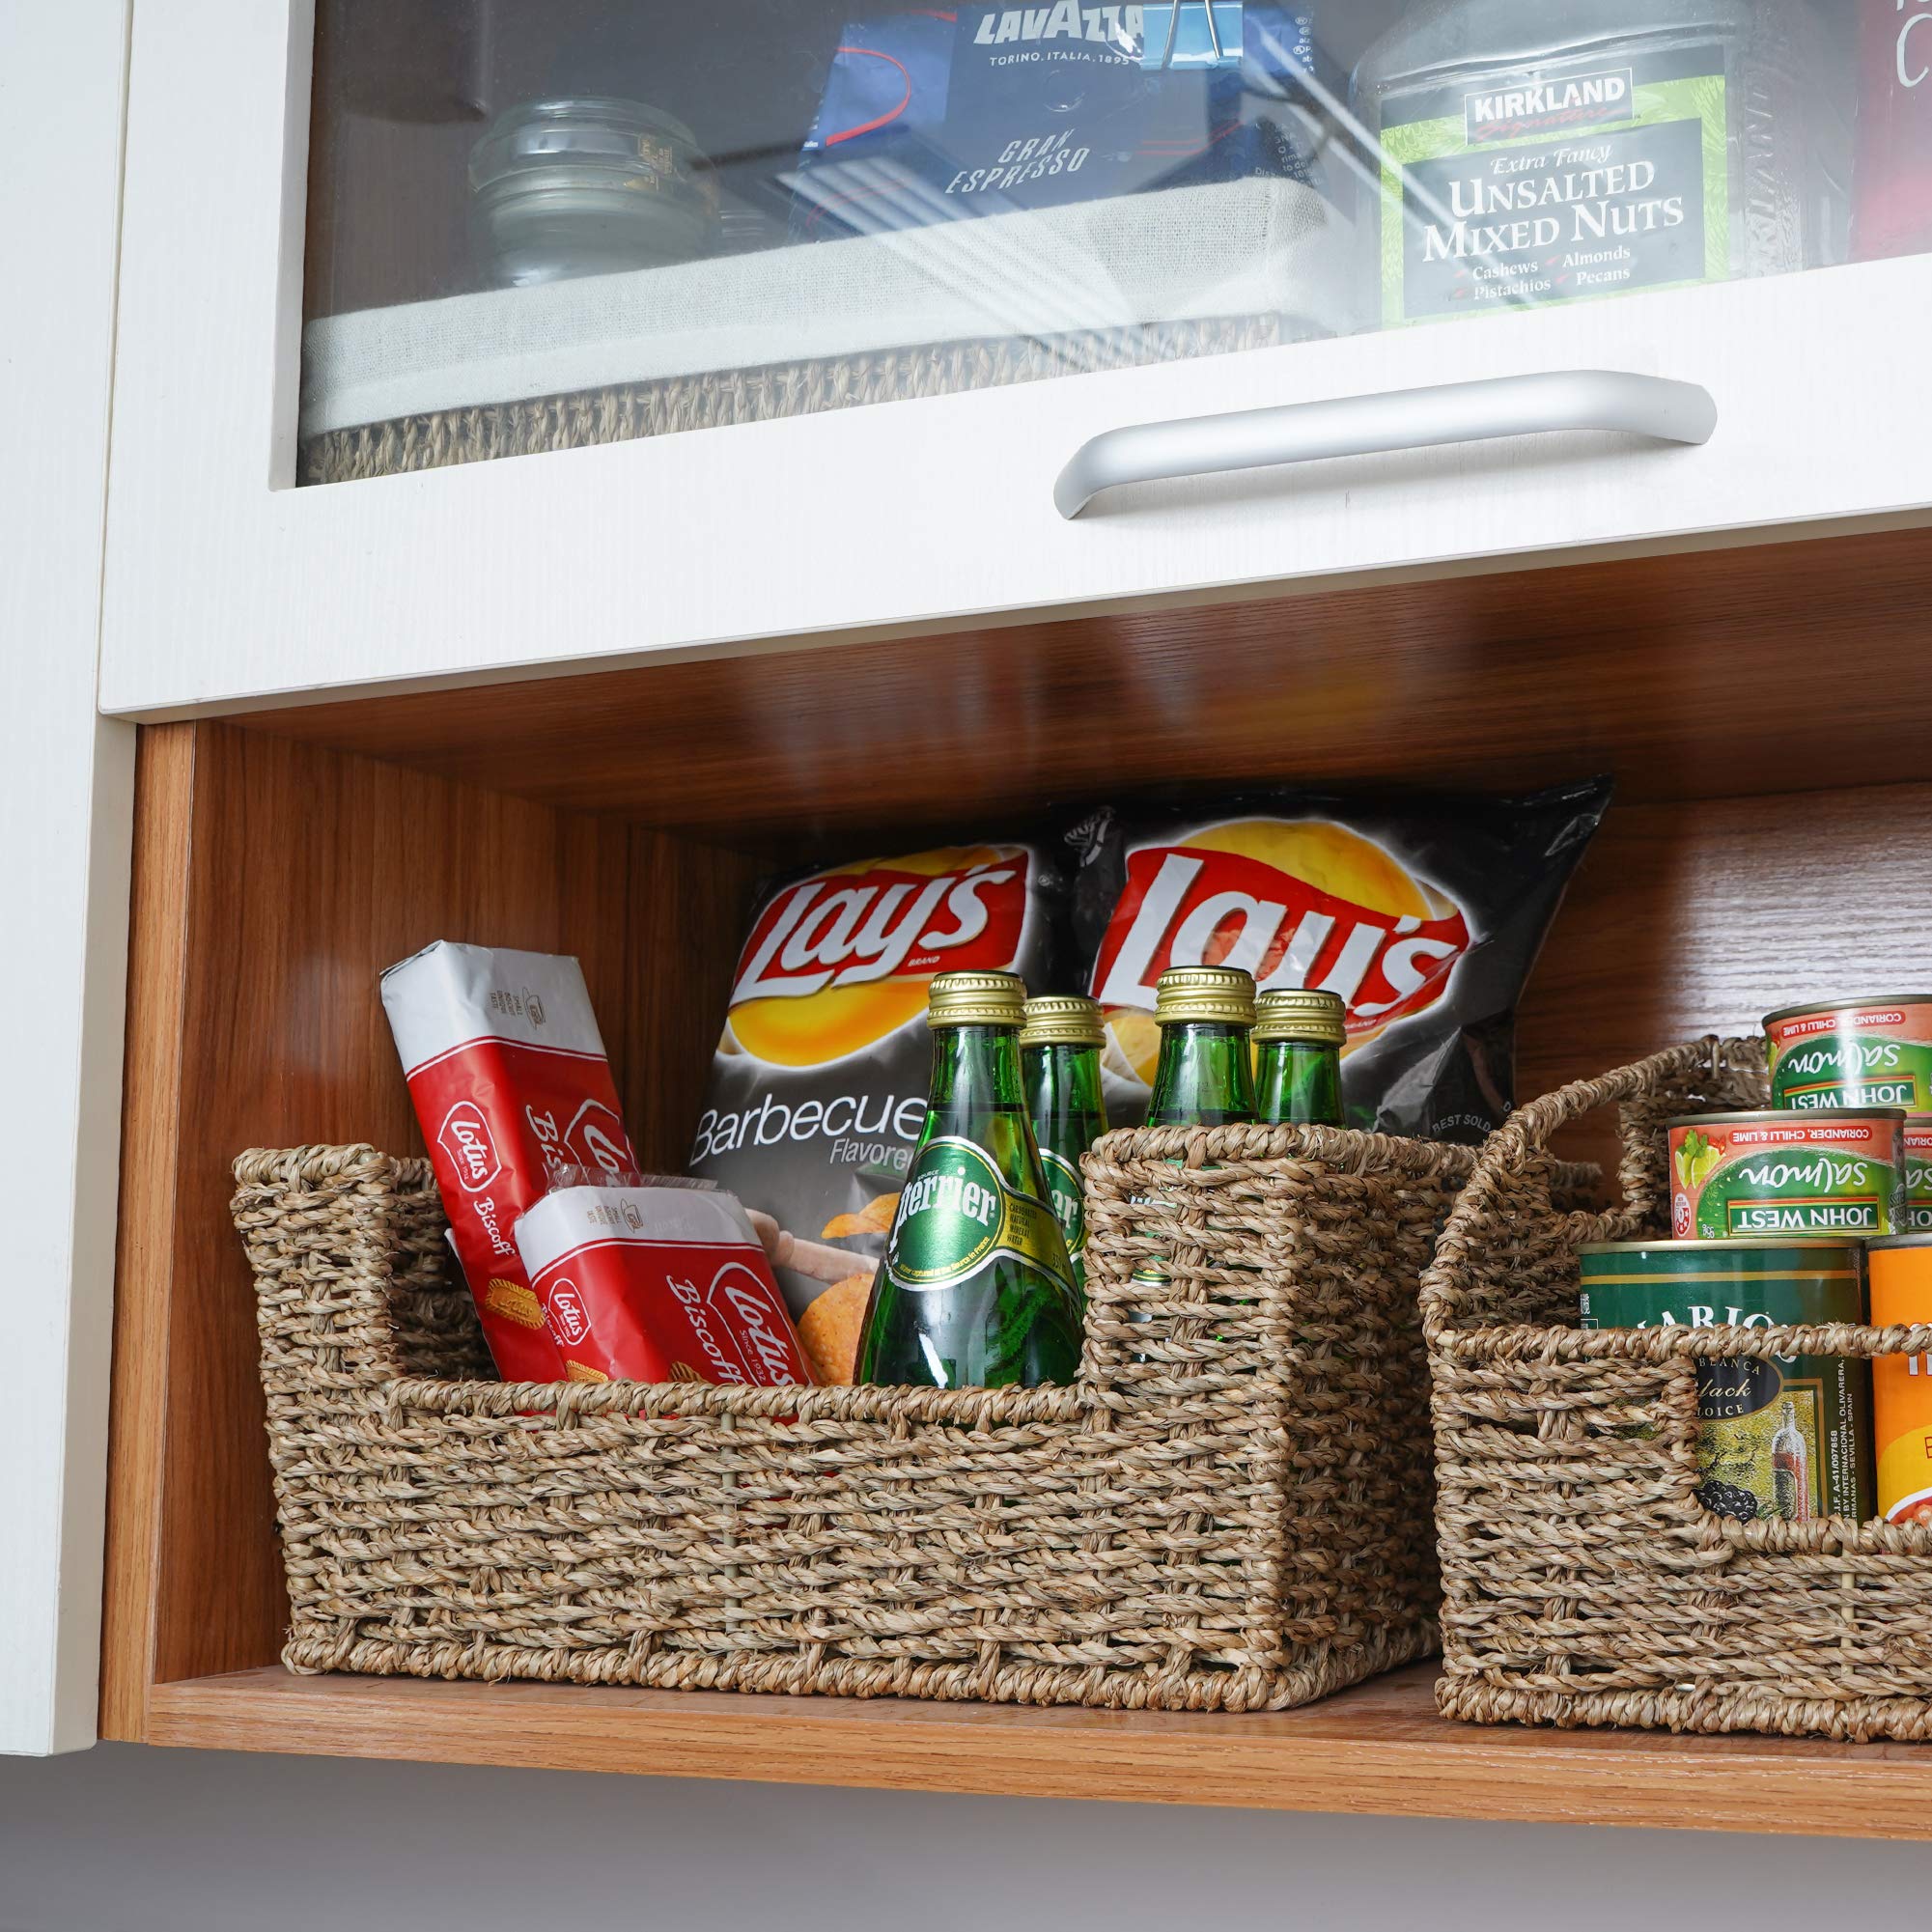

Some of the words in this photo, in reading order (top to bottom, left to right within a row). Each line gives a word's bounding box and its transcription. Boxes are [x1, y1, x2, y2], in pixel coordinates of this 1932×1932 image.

[973, 0, 1144, 44] LAVAZZA
[1475, 77, 1625, 123] KIRKLAND
[1476, 107, 1628, 142] Signature
[997, 128, 1076, 164] GRAN
[1491, 156, 1546, 175] Extra
[1554, 145, 1613, 168] Fancy
[945, 148, 1090, 194] ESPRESSO
[1422, 217, 1560, 263] MIXED
[1472, 261, 1539, 281] Cashews
[1562, 245, 1631, 267] Almonds
[1474, 279, 1552, 299] Pistachios
[1577, 266, 1631, 286] Pecans
[729, 864, 1017, 1006] Lay's
[1099, 854, 1460, 1016] Lay's
[908, 955, 940, 967] BRAND
[1782, 1024, 1800, 1037] LIME
[1800, 1022, 1807, 1031] &
[1806, 1019, 1835, 1031] CHILLI
[1791, 1091, 1838, 1109] WEST
[1842, 1084, 1907, 1105] JOHN
[689, 1094, 929, 1166] Barbecue
[1432, 1113, 1462, 1134] BEST
[1463, 1113, 1492, 1134] SOLD
[1732, 1132, 1757, 1143] LIME
[1760, 1131, 1768, 1141] &
[1770, 1130, 1805, 1141] CHILLI
[1807, 1129, 1869, 1141] CORIANDER,
[451, 1120, 489, 1180] Lotus
[1739, 1158, 1867, 1192] salmon
[473, 1196, 516, 1256] Biscoff
[1738, 1210, 1806, 1229] WEST
[1810, 1207, 1872, 1226] JOHN
[554, 1293, 583, 1336] Lotus
[665, 1274, 747, 1386] Biscoff
[725, 1286, 796, 1386] Lotus
[740, 1330, 753, 1356] Since
[751, 1358, 767, 1382] 1932
[1697, 1379, 1751, 1398] lack
[1839, 1418, 1849, 1496] INTERNACIONAL
[1842, 1498, 1850, 1512] BY
